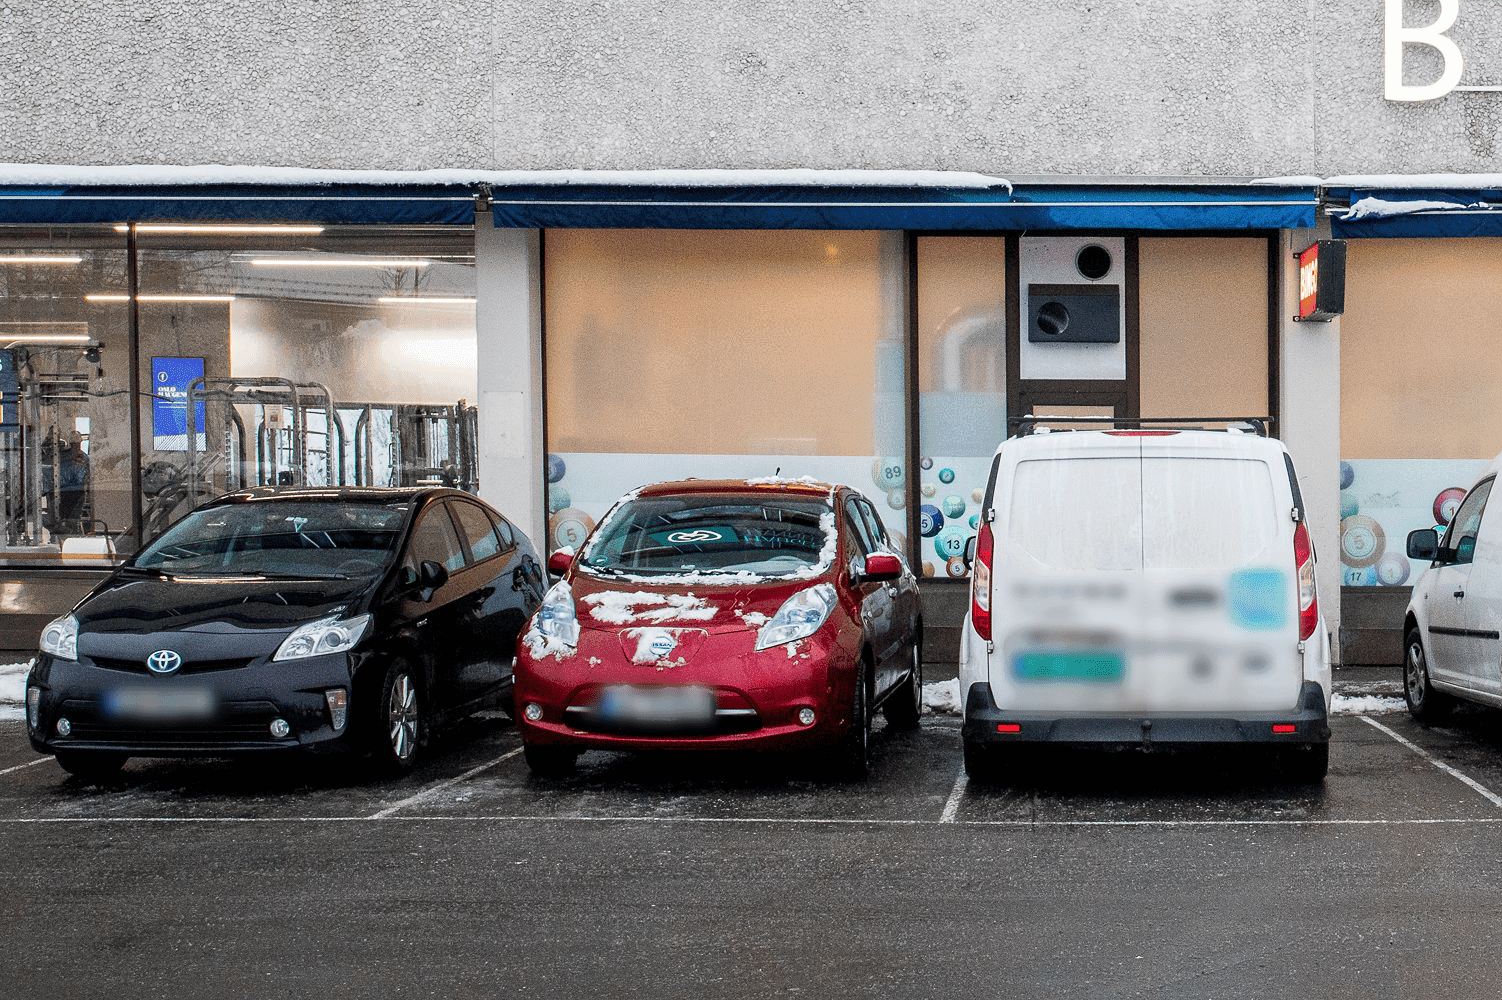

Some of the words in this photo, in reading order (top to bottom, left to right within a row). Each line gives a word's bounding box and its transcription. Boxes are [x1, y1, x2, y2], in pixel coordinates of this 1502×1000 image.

[885, 466, 901, 479] 89
[566, 528, 577, 542] 5
[947, 540, 960, 550] 13
[1354, 536, 1365, 549] 5
[1350, 572, 1362, 581] 17
